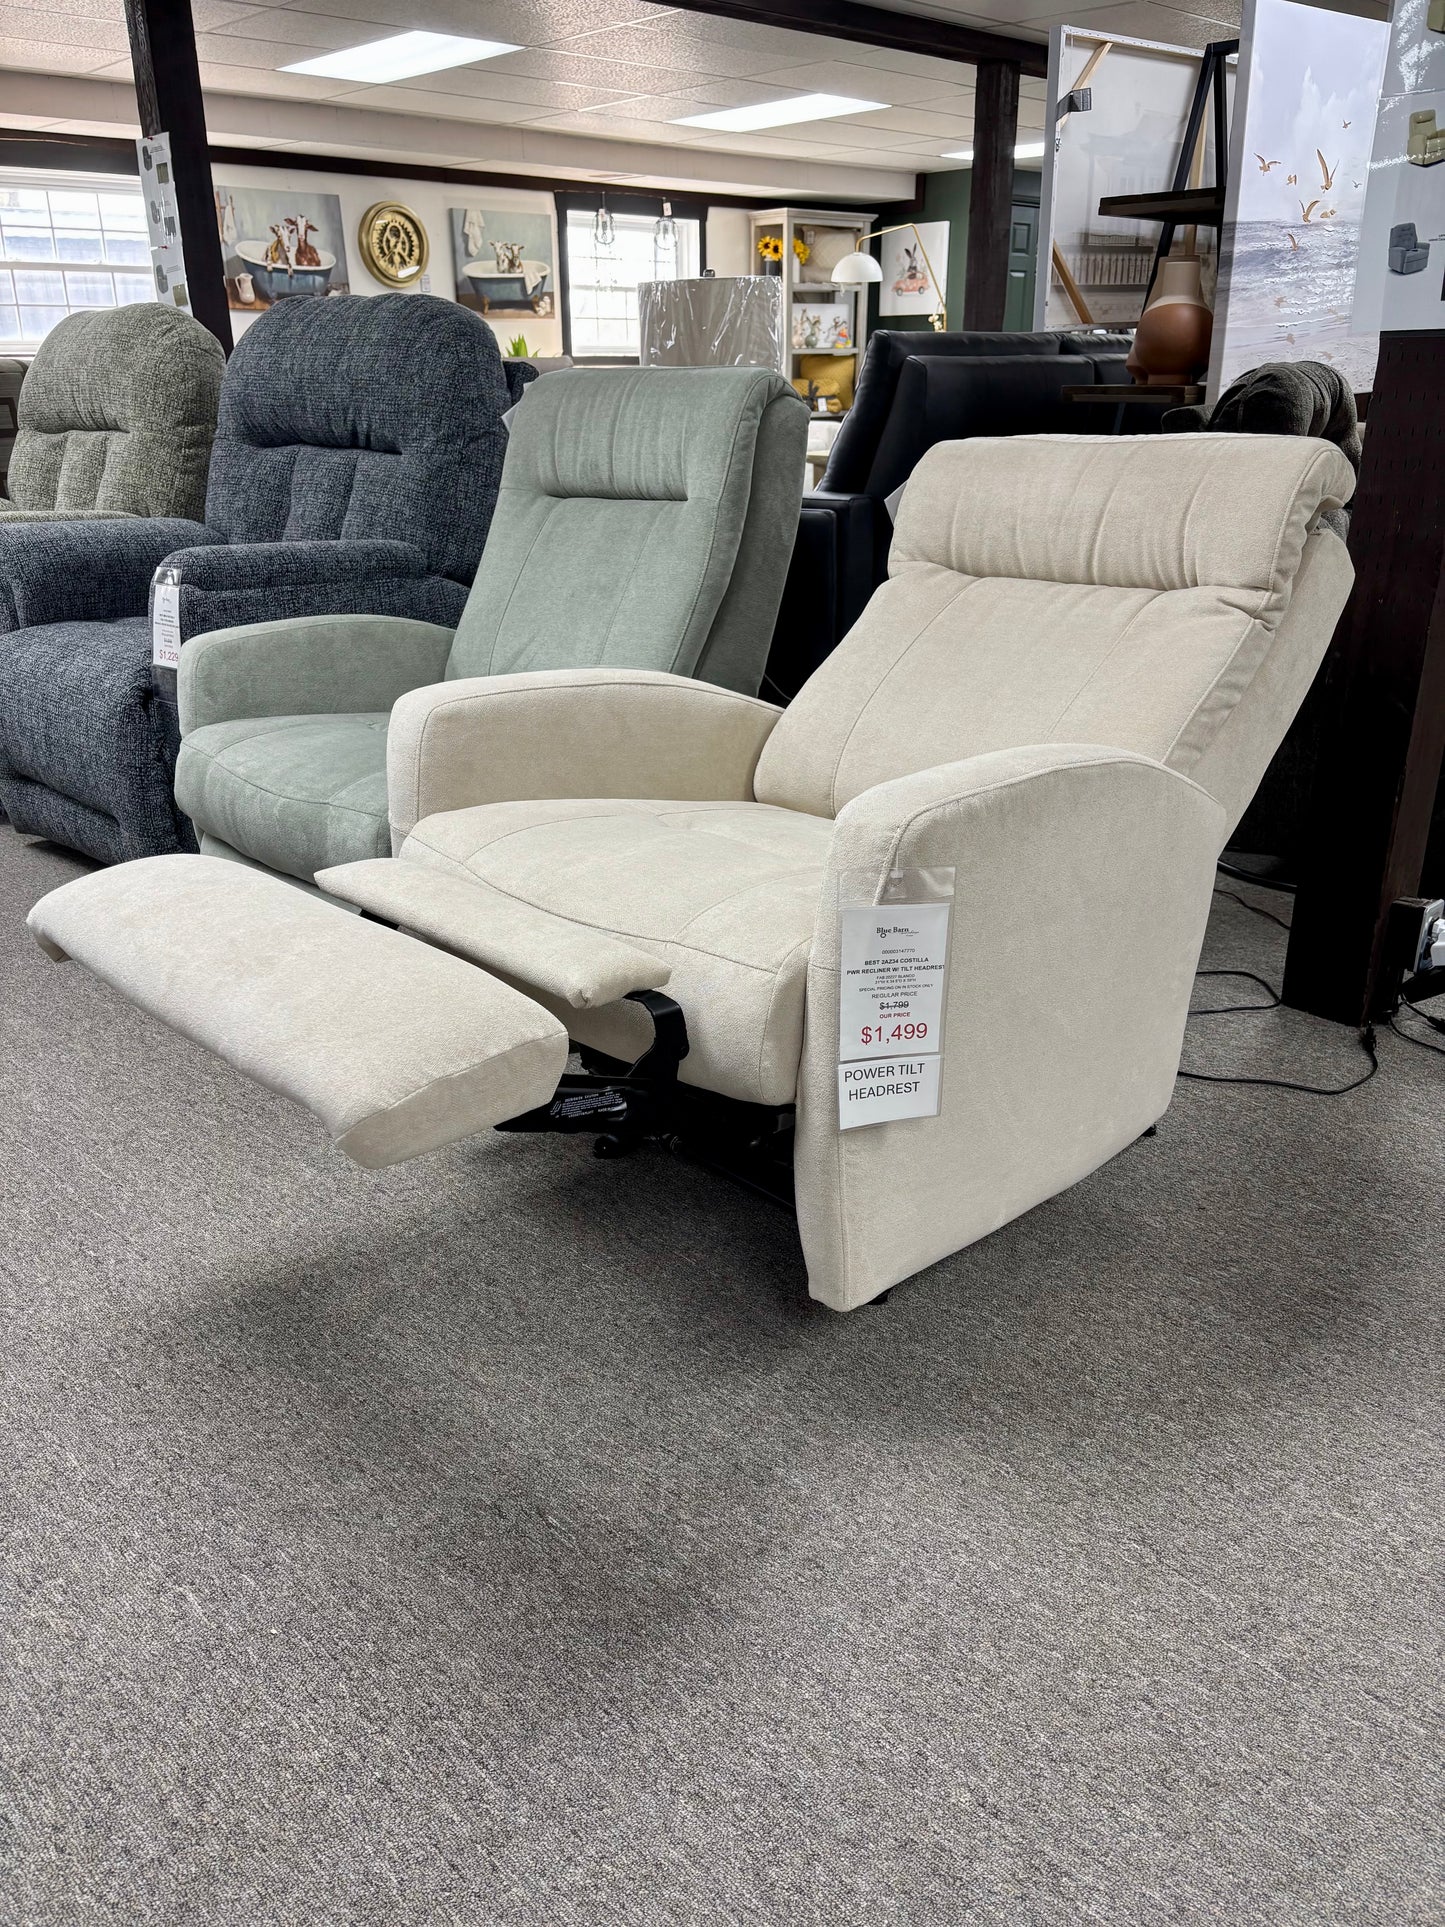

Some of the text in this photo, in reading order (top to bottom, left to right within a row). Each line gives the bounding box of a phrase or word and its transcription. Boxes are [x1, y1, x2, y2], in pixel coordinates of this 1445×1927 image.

[876, 927, 892, 938] Blue
[879, 1001, 909, 1010] $1,799
[861, 1022, 928, 1045] $1,499
[845, 1063, 925, 1082] POWER TILT
[849, 1081, 920, 1101] HEADREST
